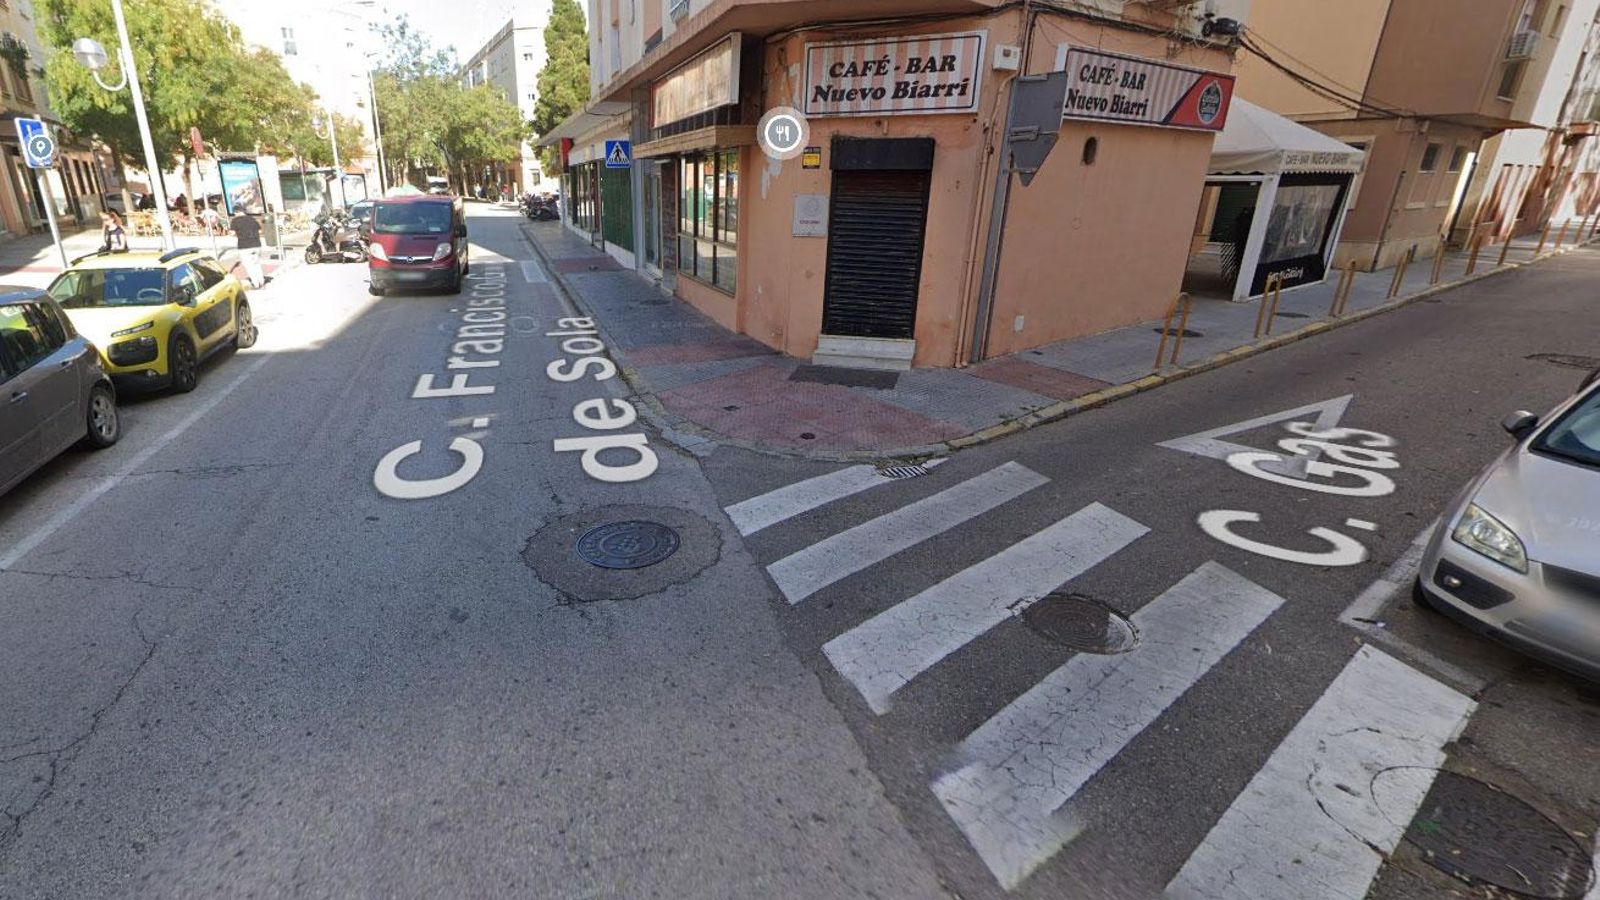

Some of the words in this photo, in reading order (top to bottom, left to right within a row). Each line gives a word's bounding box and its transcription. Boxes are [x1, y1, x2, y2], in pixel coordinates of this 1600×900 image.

[829, 54, 890, 78] CAFÉ
[905, 55, 957, 74] BAR
[1080, 63, 1115, 85] CAFÉ
[1120, 71, 1146, 90] BAR
[812, 86, 886, 102] Nuevo
[1065, 88, 1108, 112] Nuevo
